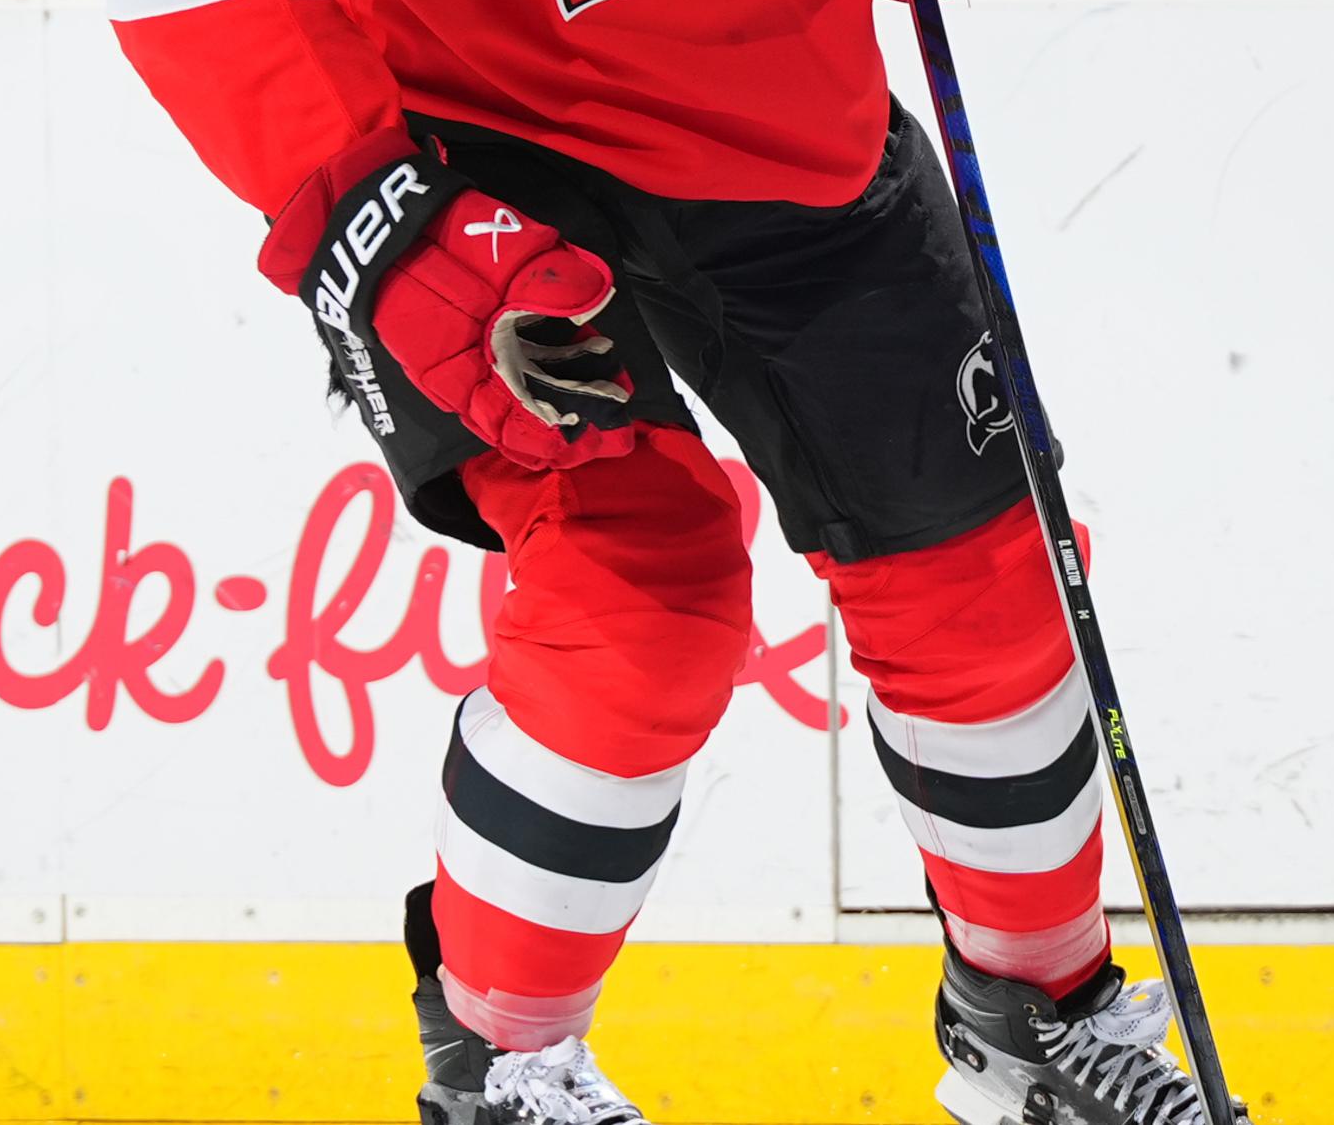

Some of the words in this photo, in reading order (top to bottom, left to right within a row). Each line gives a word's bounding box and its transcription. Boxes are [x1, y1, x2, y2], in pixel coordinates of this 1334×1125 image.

[316, 162, 431, 332] AUER
[1060, 548, 1083, 587] HAMILTON
[1107, 707, 1127, 760] FLYLITE
